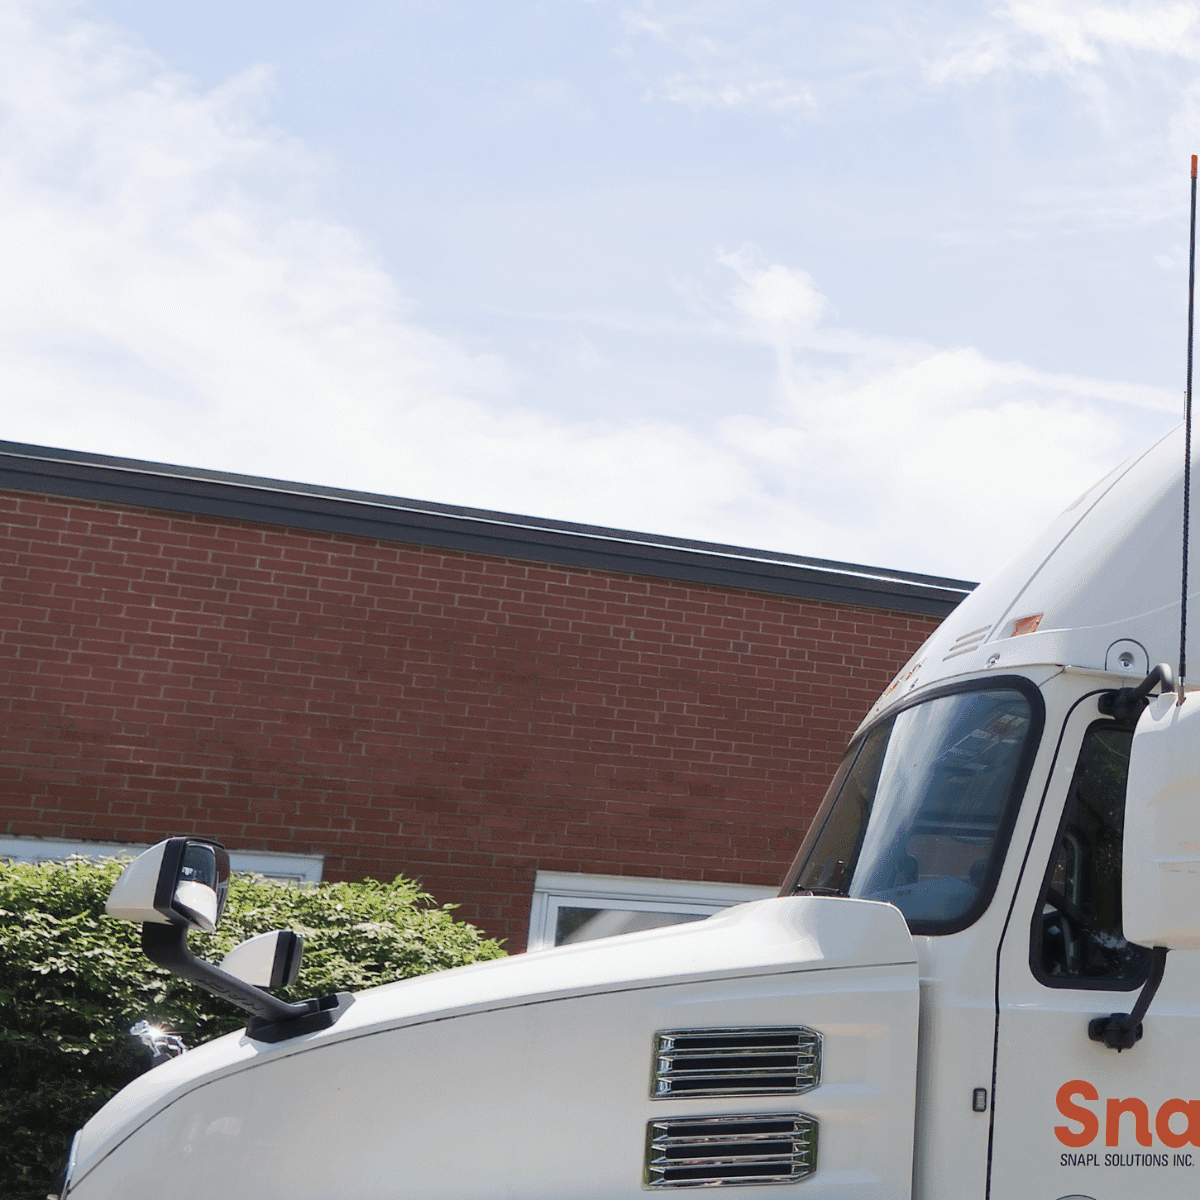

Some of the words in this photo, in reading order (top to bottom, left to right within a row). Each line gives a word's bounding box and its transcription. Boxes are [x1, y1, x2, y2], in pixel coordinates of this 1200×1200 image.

[1060, 1153, 1100, 1167] SNAPL
[1104, 1153, 1169, 1167] SOLUTIONS
[1173, 1153, 1195, 1167] INC.
